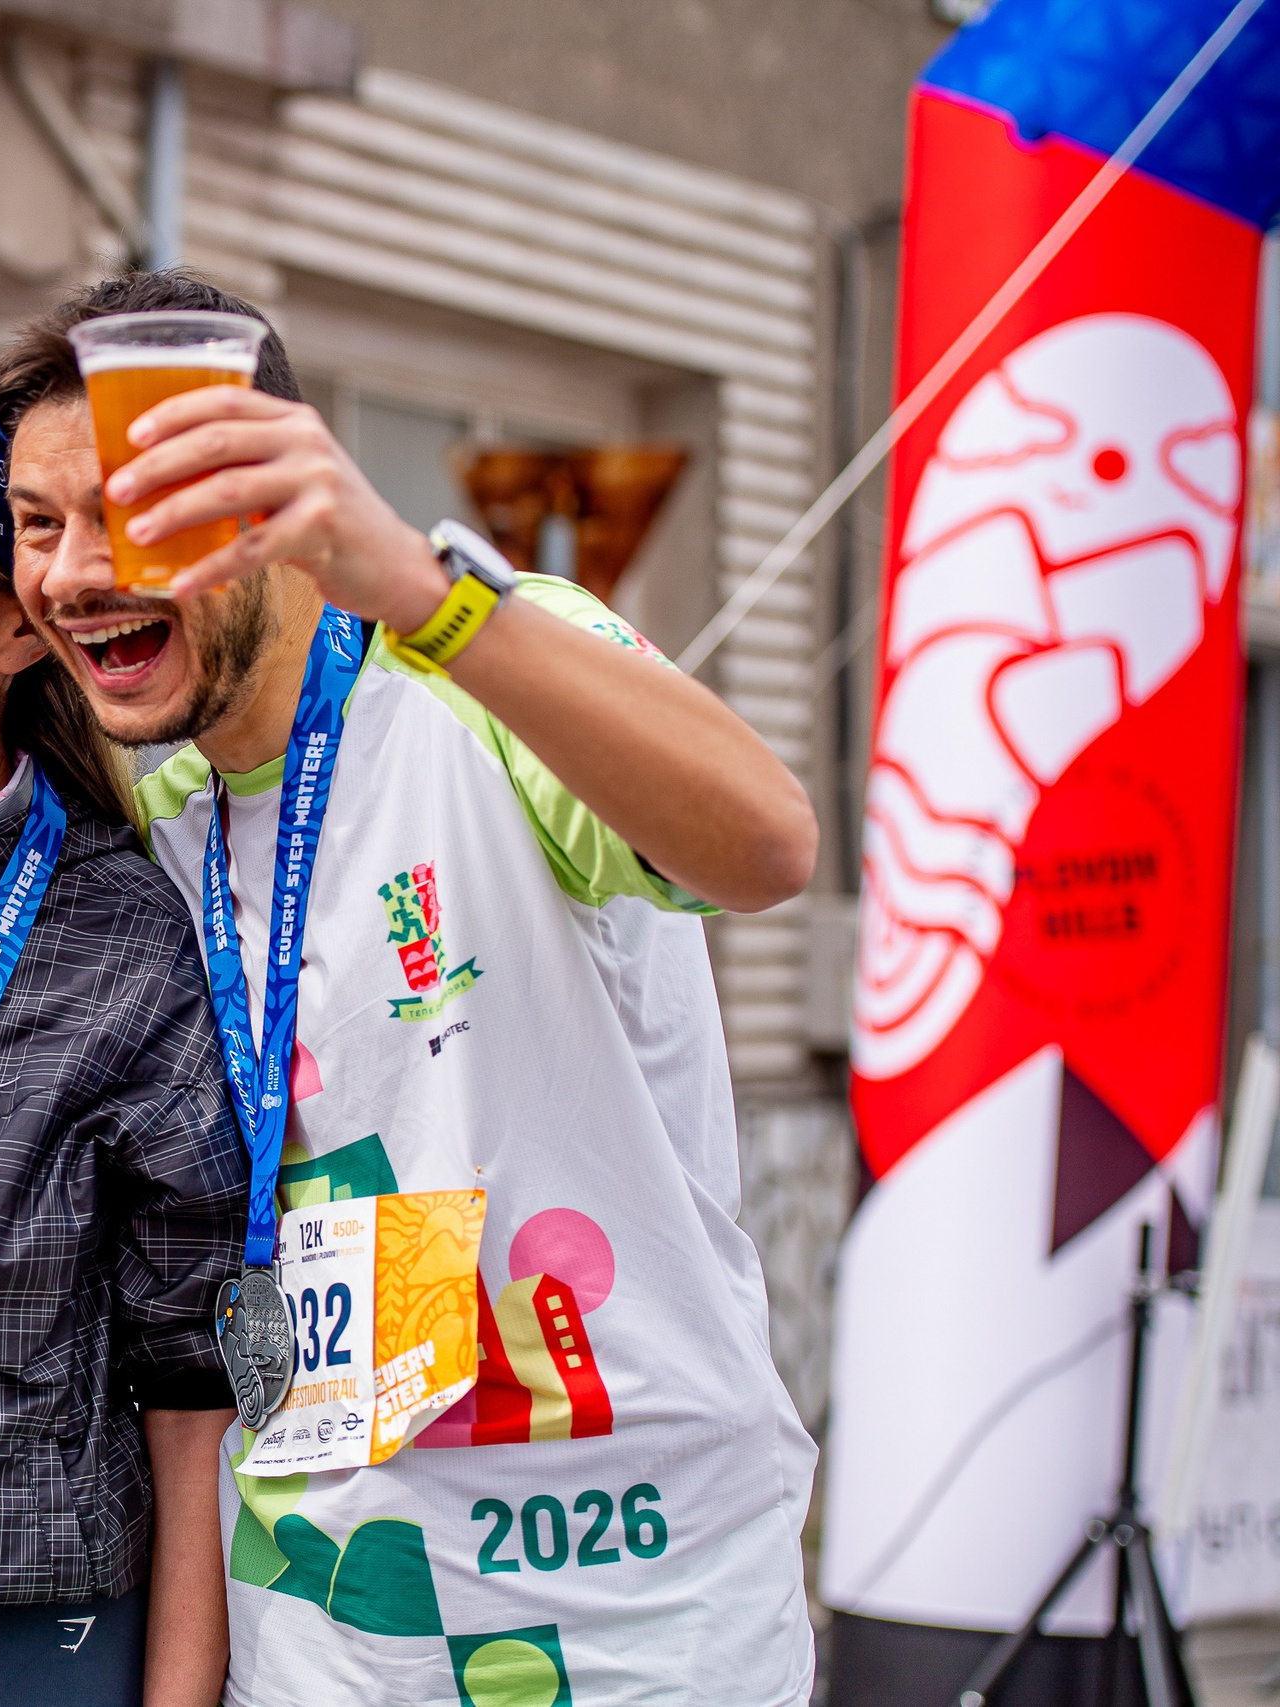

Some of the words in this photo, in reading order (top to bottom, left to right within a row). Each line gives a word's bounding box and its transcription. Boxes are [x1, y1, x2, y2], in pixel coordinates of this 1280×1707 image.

[293, 732, 328, 826] MATTERS
[285, 833, 305, 888] STEP
[210, 857, 228, 952] MATTERS
[278, 894, 296, 966] EVERY
[299, 1219, 324, 1250] 12K
[332, 1220, 366, 1237] 450D+
[327, 1377, 359, 1402] TRAIL
[373, 1339, 436, 1397] EVERY
[376, 1372, 428, 1421] STEP
[470, 1482, 668, 1575] 2026
